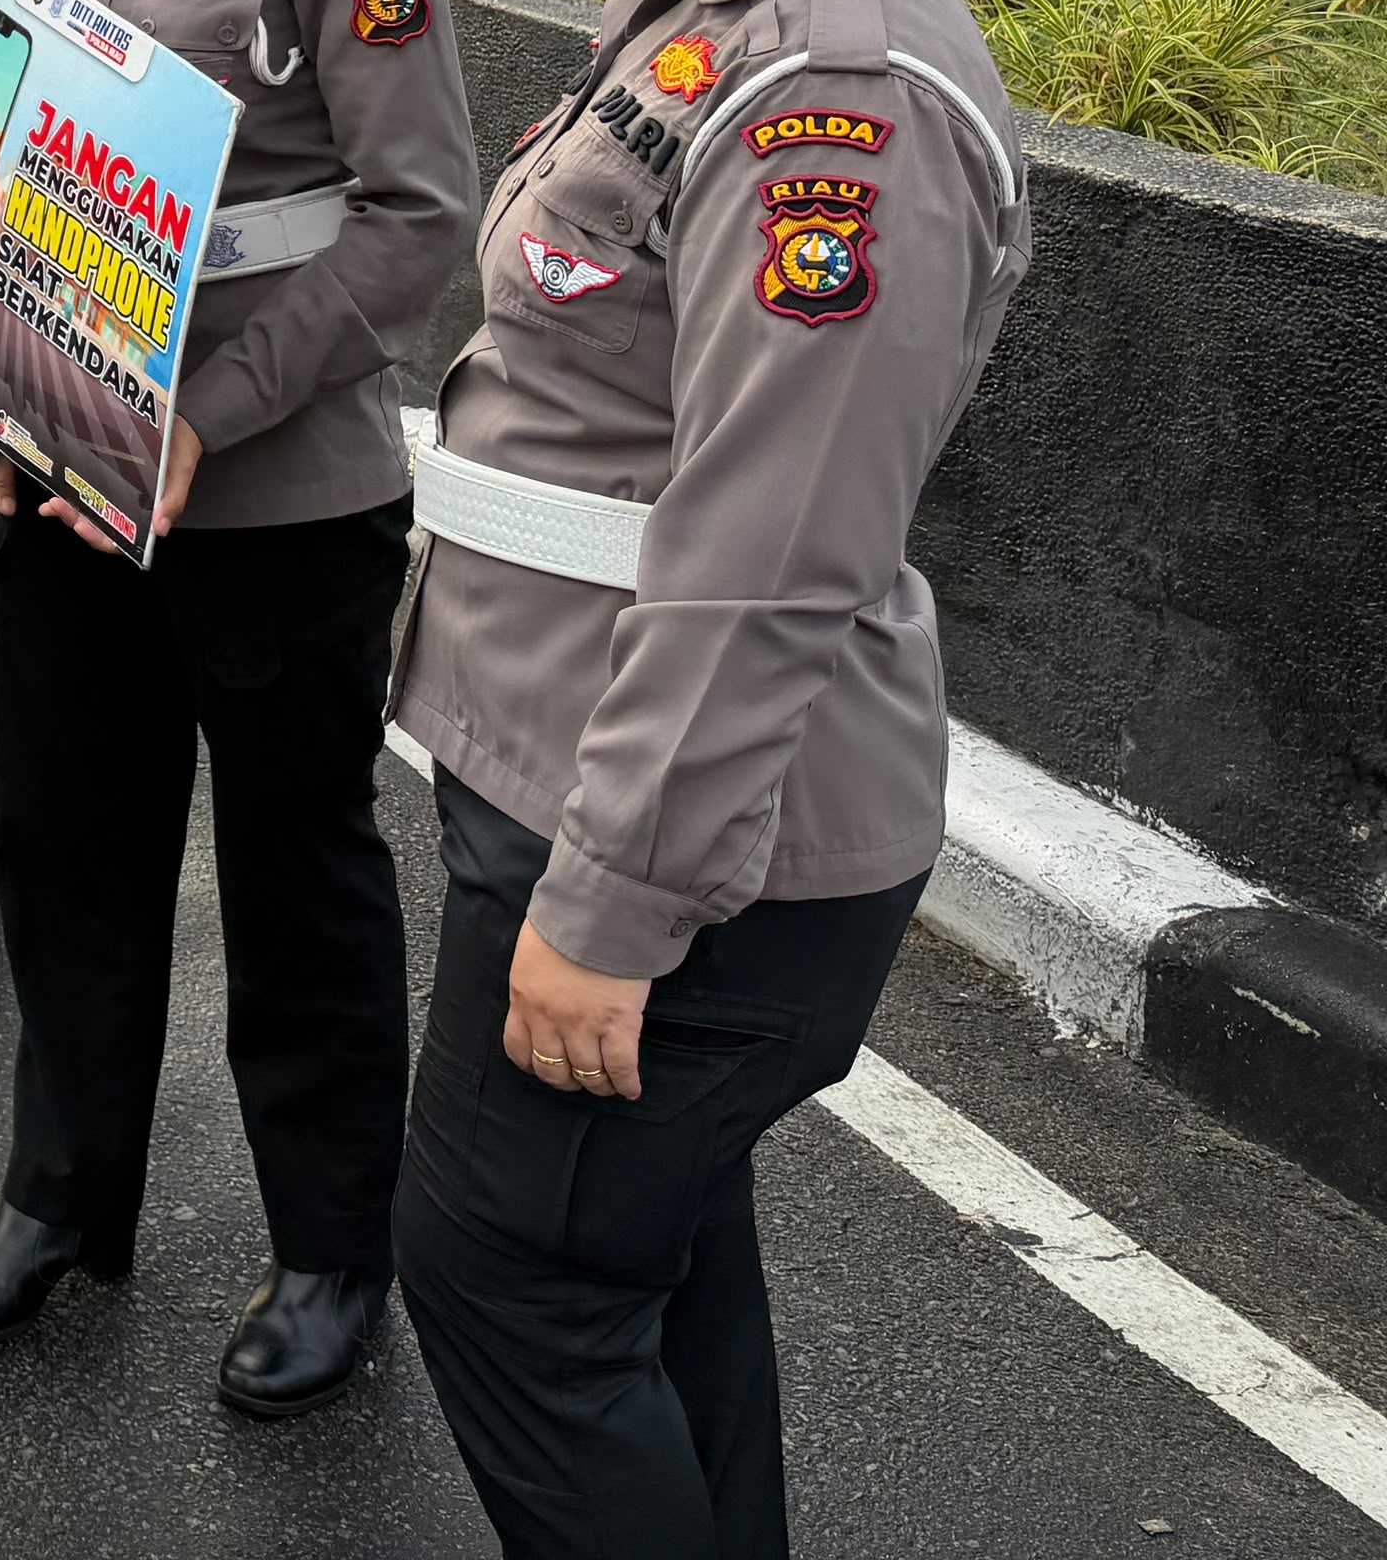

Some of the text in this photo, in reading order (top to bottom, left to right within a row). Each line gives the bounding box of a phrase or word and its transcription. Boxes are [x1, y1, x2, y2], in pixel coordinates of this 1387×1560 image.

[70, 0, 133, 52] DITLANTAS
[590, 84, 680, 175] POLRI
[754, 117, 876, 146] POLDA
[19, 145, 179, 285] MENGGUNAKAN
[28, 99, 193, 253] JANGAN
[772, 183, 861, 200] RIAU
[4, 173, 175, 352] HANDPHONE
